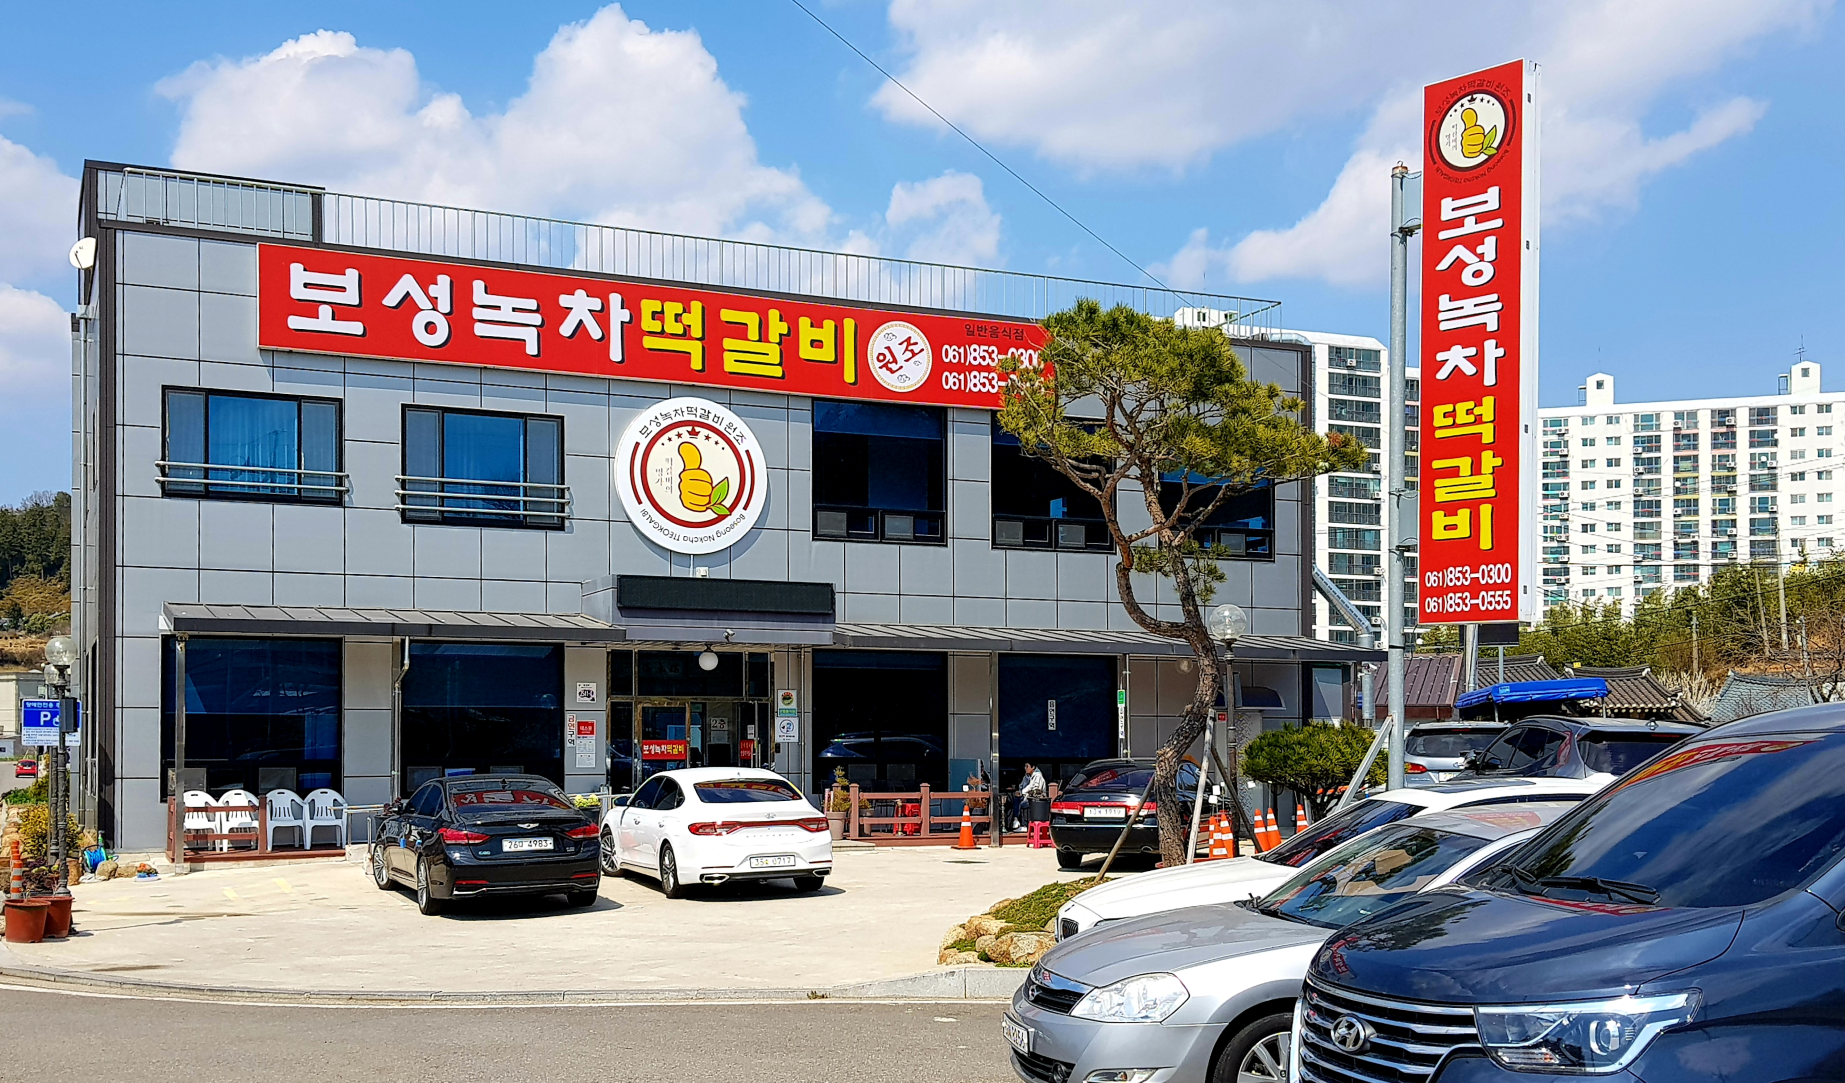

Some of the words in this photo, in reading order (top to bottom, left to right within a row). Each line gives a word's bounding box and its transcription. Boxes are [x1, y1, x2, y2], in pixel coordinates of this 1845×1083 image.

[287, 262, 858, 384] 보성녹차떡갈비
[964, 323, 1024, 341] 일반음식점
[876, 336, 925, 374] 원조
[1432, 186, 1506, 550] 보성녹차떡갈비
[639, 406, 725, 439] 보성녹차떡갈비
[723, 421, 747, 446] 원조
[716, 513, 746, 539] Boseong
[682, 534, 716, 544] Nokcha
[1425, 563, 1512, 588] 061)853-0300
[1425, 590, 1511, 614] 061)853-0555
[40, 711, 52, 726] P
[567, 714, 575, 746] 금연구역
[527, 839, 549, 848] 4983
